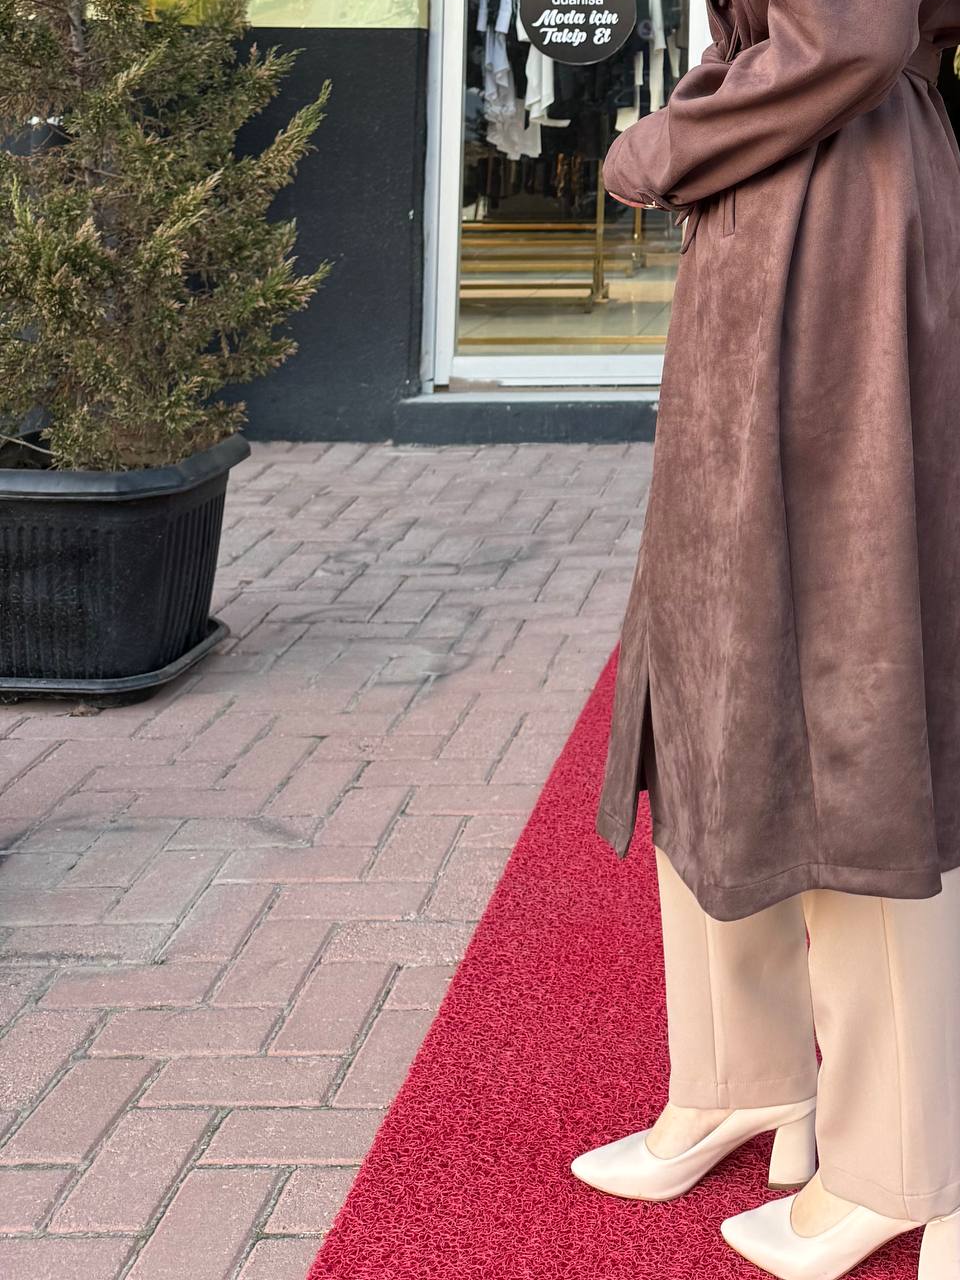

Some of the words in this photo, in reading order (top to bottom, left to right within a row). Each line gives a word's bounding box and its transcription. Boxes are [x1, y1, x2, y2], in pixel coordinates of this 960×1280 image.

[531, 9, 586, 27] Moda
[589, 10, 619, 26] için
[539, 27, 588, 47] Takip
[592, 27, 612, 45] Et
